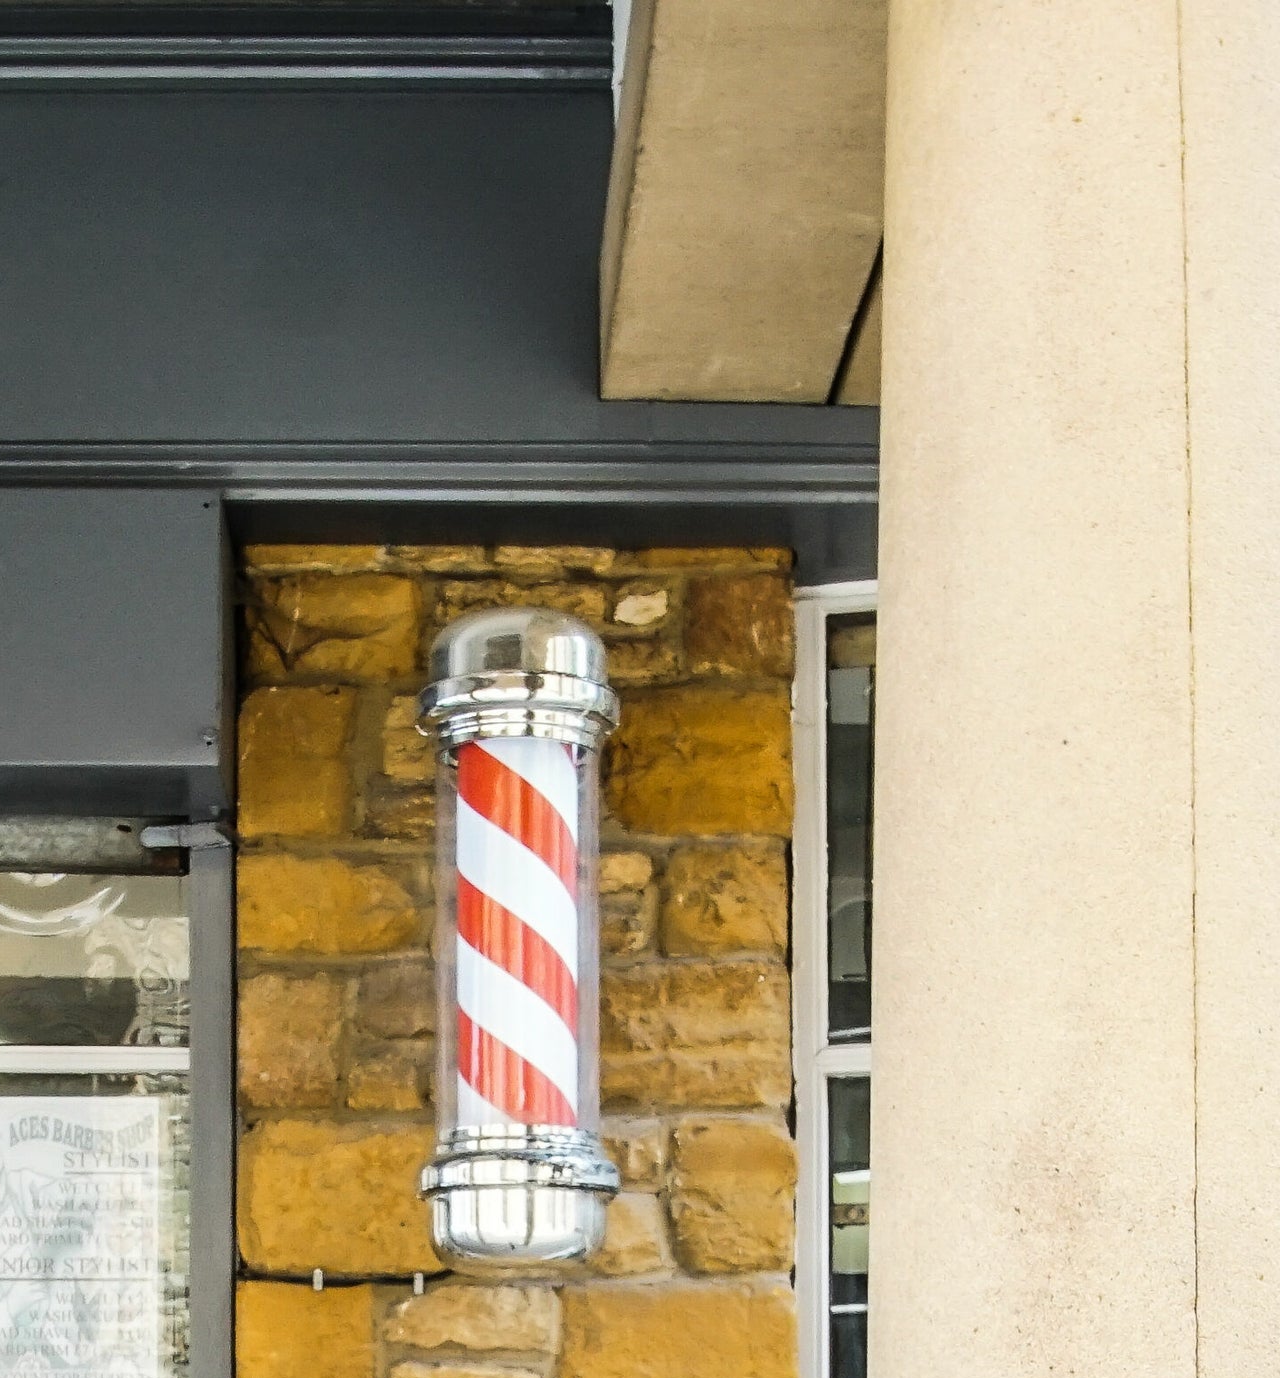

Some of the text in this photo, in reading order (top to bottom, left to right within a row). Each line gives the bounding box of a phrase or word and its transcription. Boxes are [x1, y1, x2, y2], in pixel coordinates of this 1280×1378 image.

[9, 1115, 49, 1147] ACES
[63, 1151, 151, 1168] STYLIST
[63, 1256, 152, 1273] STYLIST
